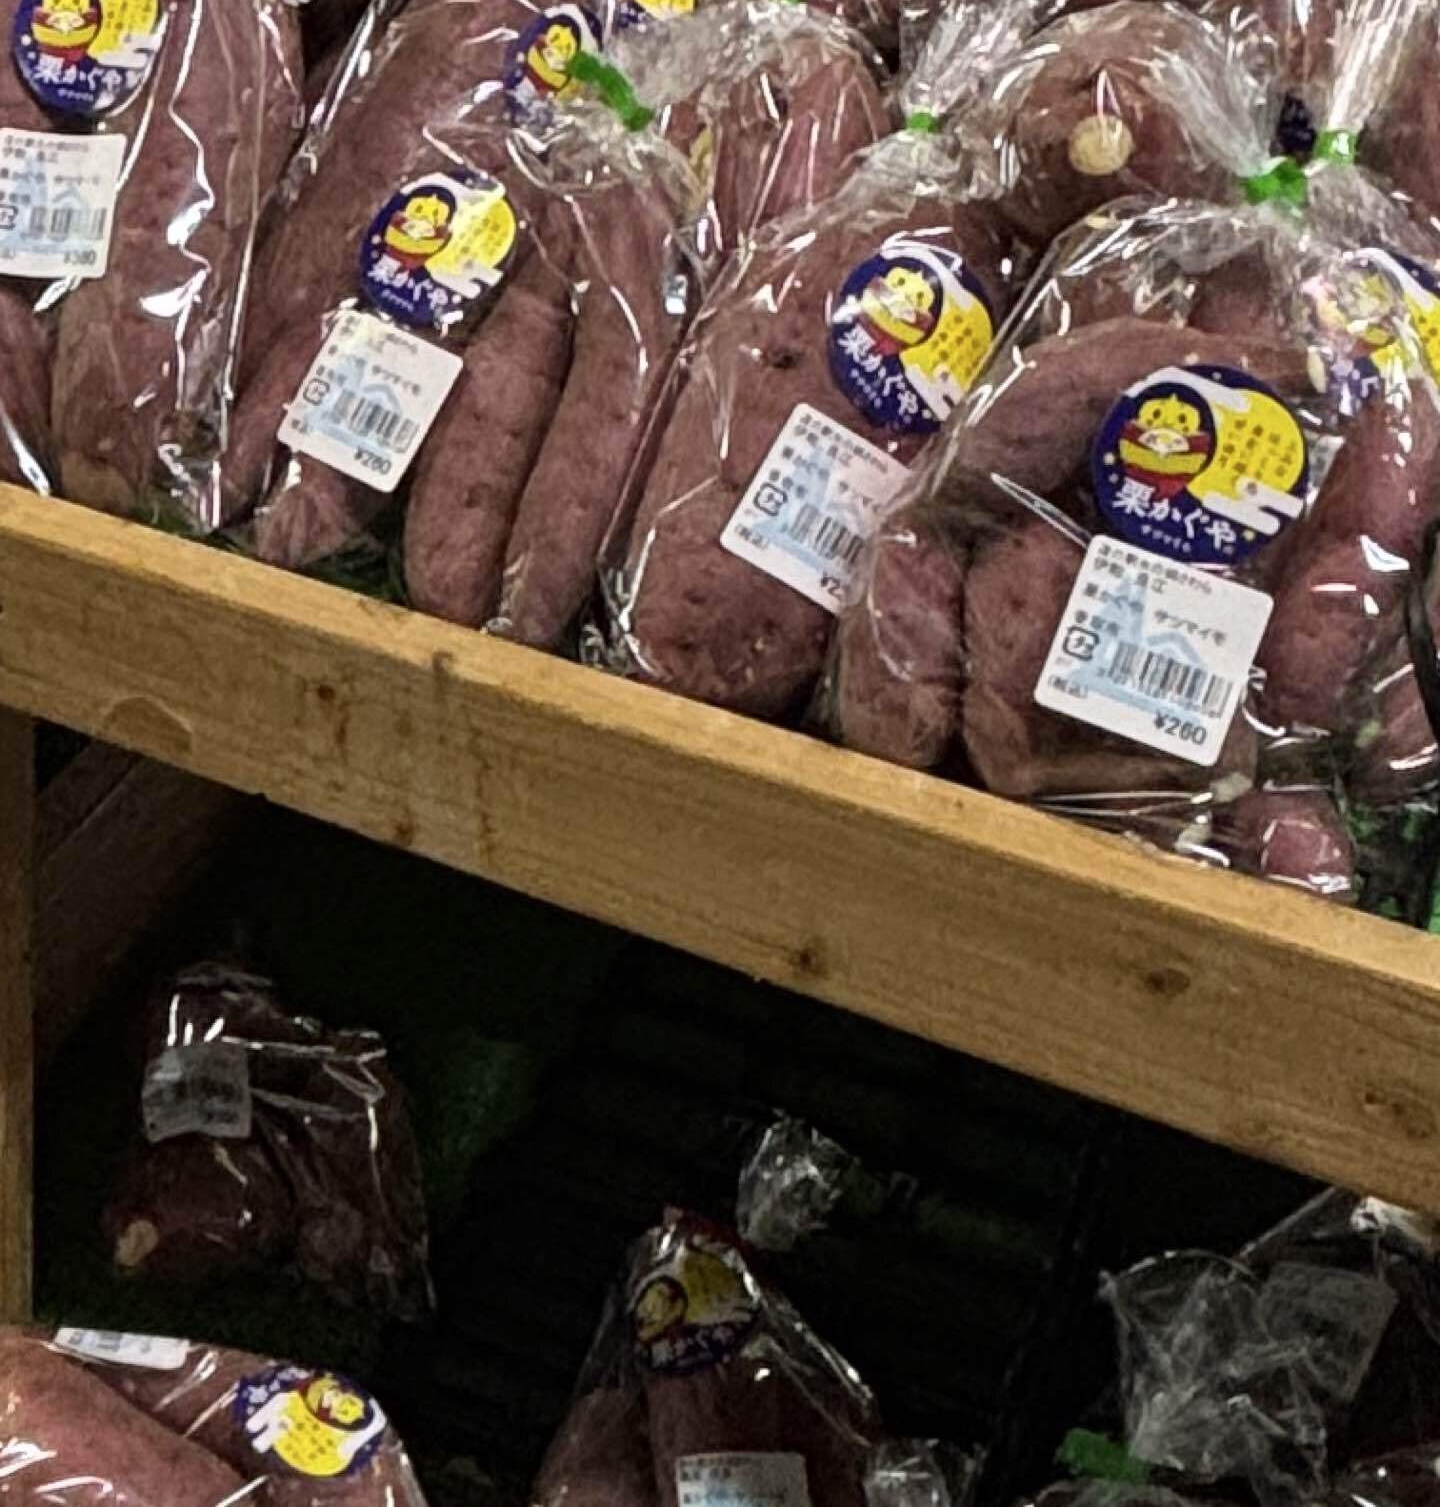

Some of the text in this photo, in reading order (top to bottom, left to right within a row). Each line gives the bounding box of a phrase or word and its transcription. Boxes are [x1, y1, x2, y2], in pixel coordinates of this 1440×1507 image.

[840, 327, 922, 419] 栗かぐや
[1109, 478, 1239, 552] 栗かぐや
[1154, 711, 1209, 748] ¥260
